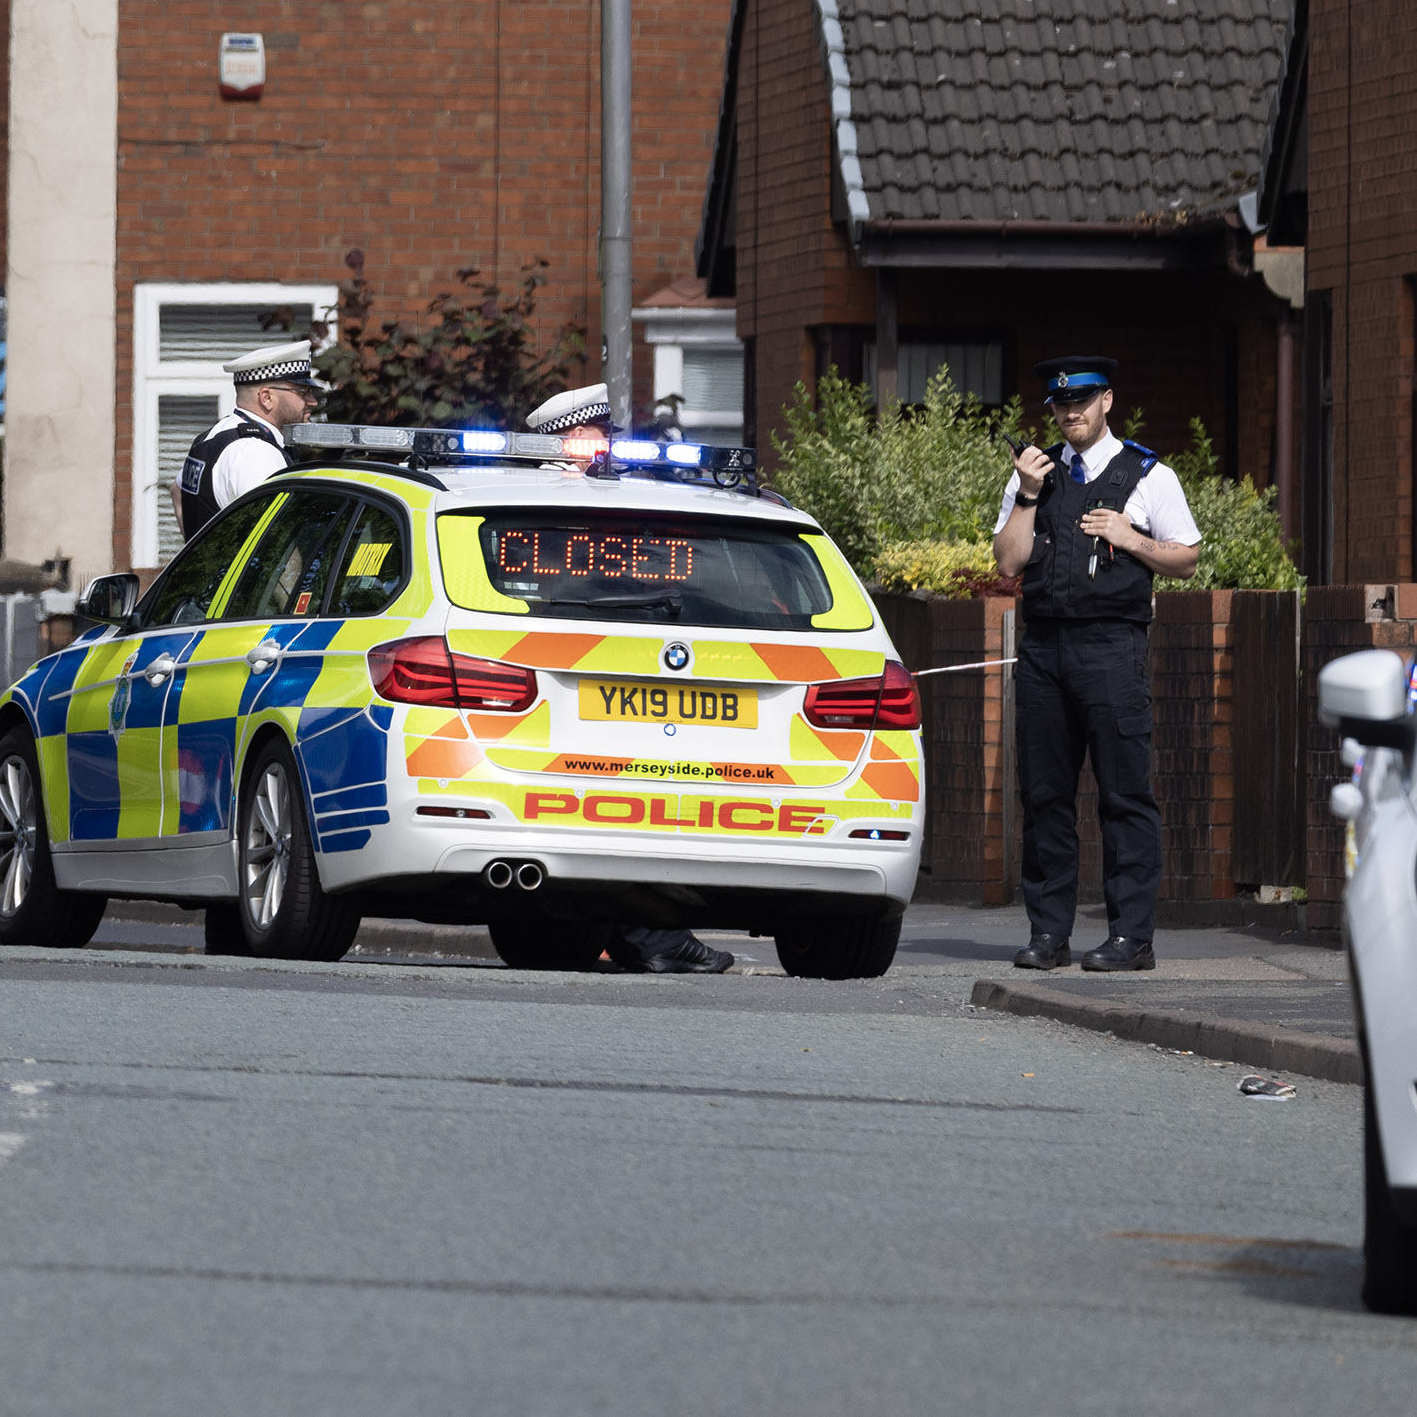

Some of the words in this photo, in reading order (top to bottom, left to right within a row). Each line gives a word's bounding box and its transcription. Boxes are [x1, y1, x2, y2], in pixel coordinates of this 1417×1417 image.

[499, 531, 694, 581] CLOSED
[599, 685, 668, 718] YK19
[678, 689, 739, 722] UDB
[564, 759, 775, 780] www.merseyside.police.uk
[523, 791, 826, 834] POLICE
